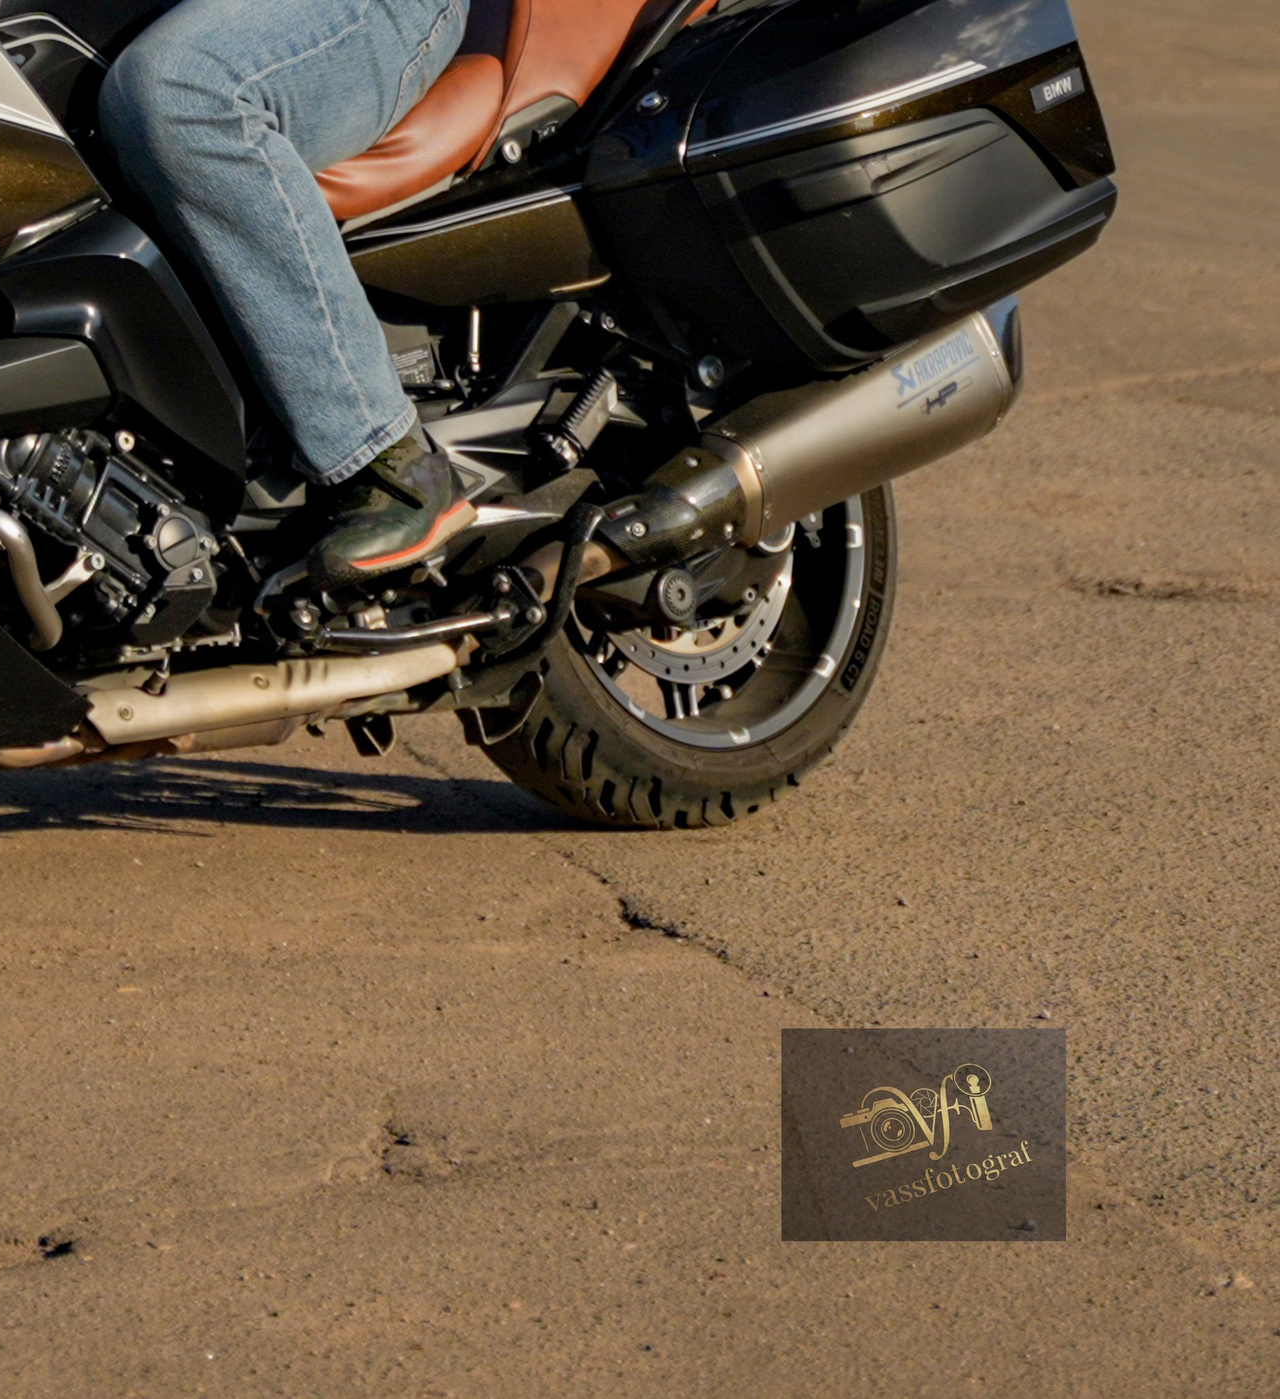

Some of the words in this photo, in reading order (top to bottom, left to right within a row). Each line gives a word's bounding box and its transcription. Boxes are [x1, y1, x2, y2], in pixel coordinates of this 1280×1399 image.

[1043, 76, 1072, 101] BMW
[926, 380, 958, 415] HP
[861, 597, 880, 649] ROAD
[854, 650, 865, 664] 6
[845, 665, 860, 688] GT
